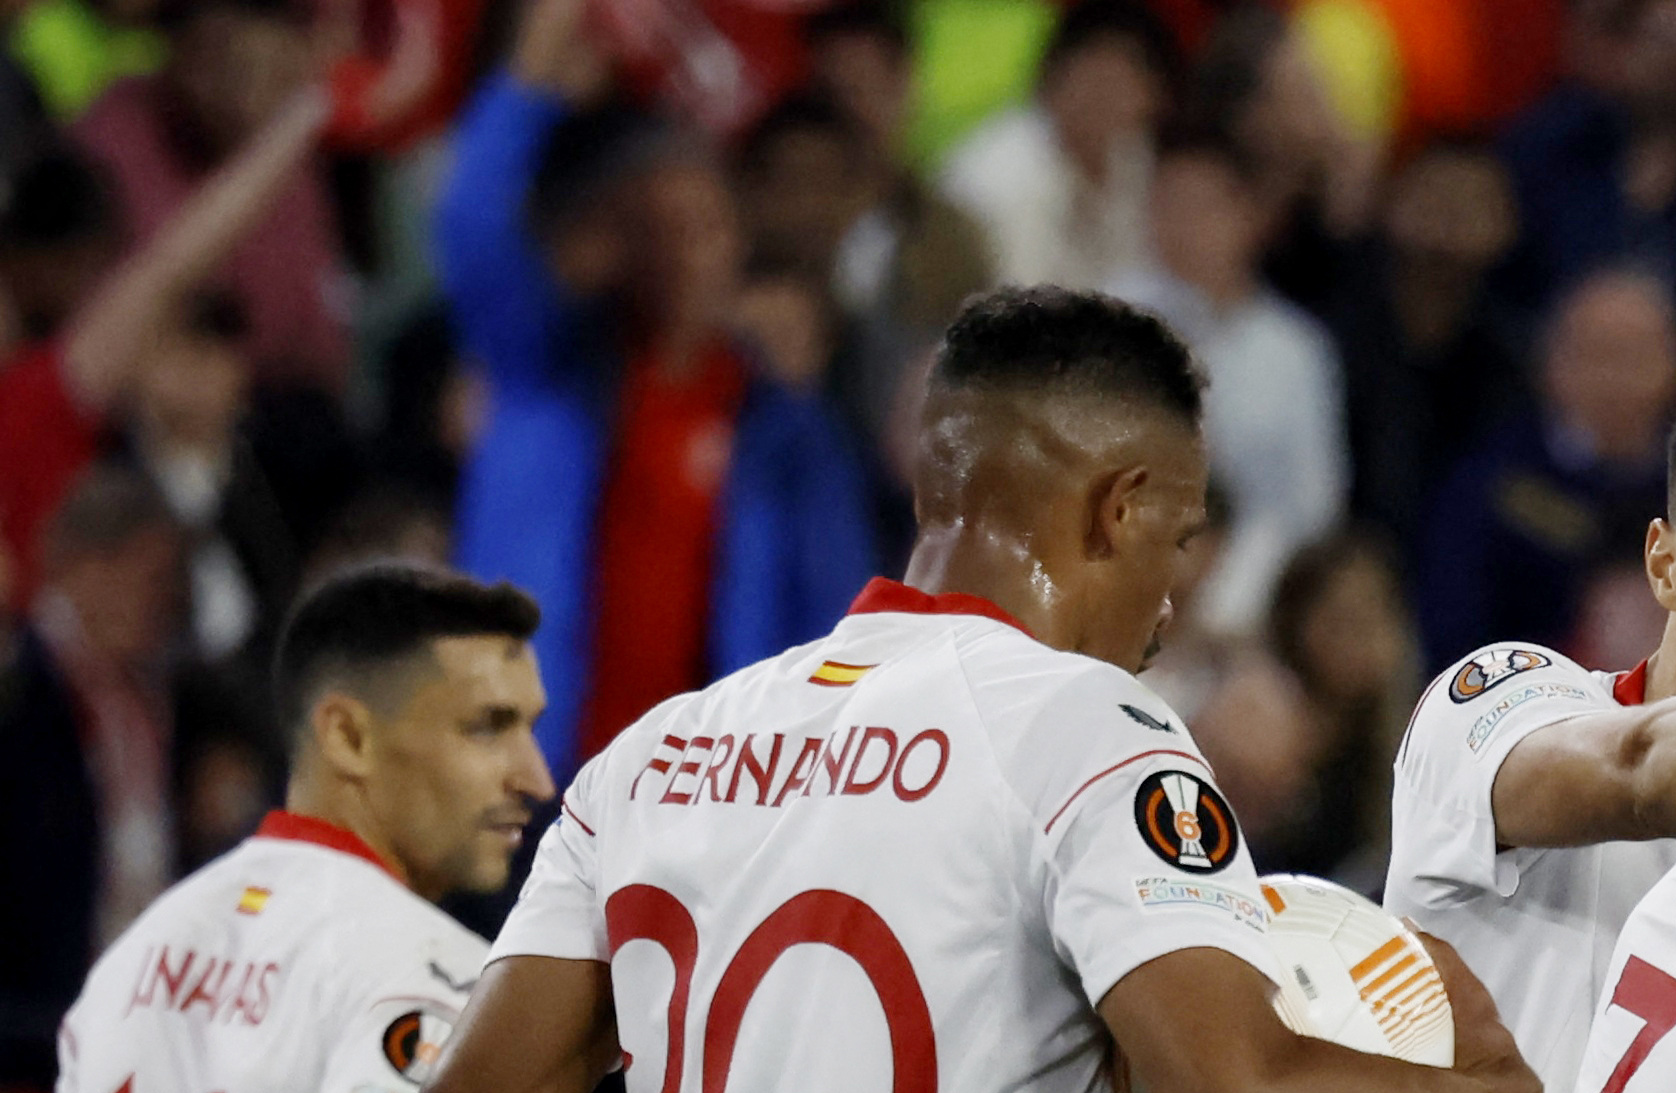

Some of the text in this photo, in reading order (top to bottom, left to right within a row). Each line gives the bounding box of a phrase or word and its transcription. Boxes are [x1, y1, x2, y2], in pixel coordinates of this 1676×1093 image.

[631, 726, 950, 807] FERNANDO
[1176, 811, 1201, 841] 6
[1138, 886, 1265, 923] FOUNDATION
